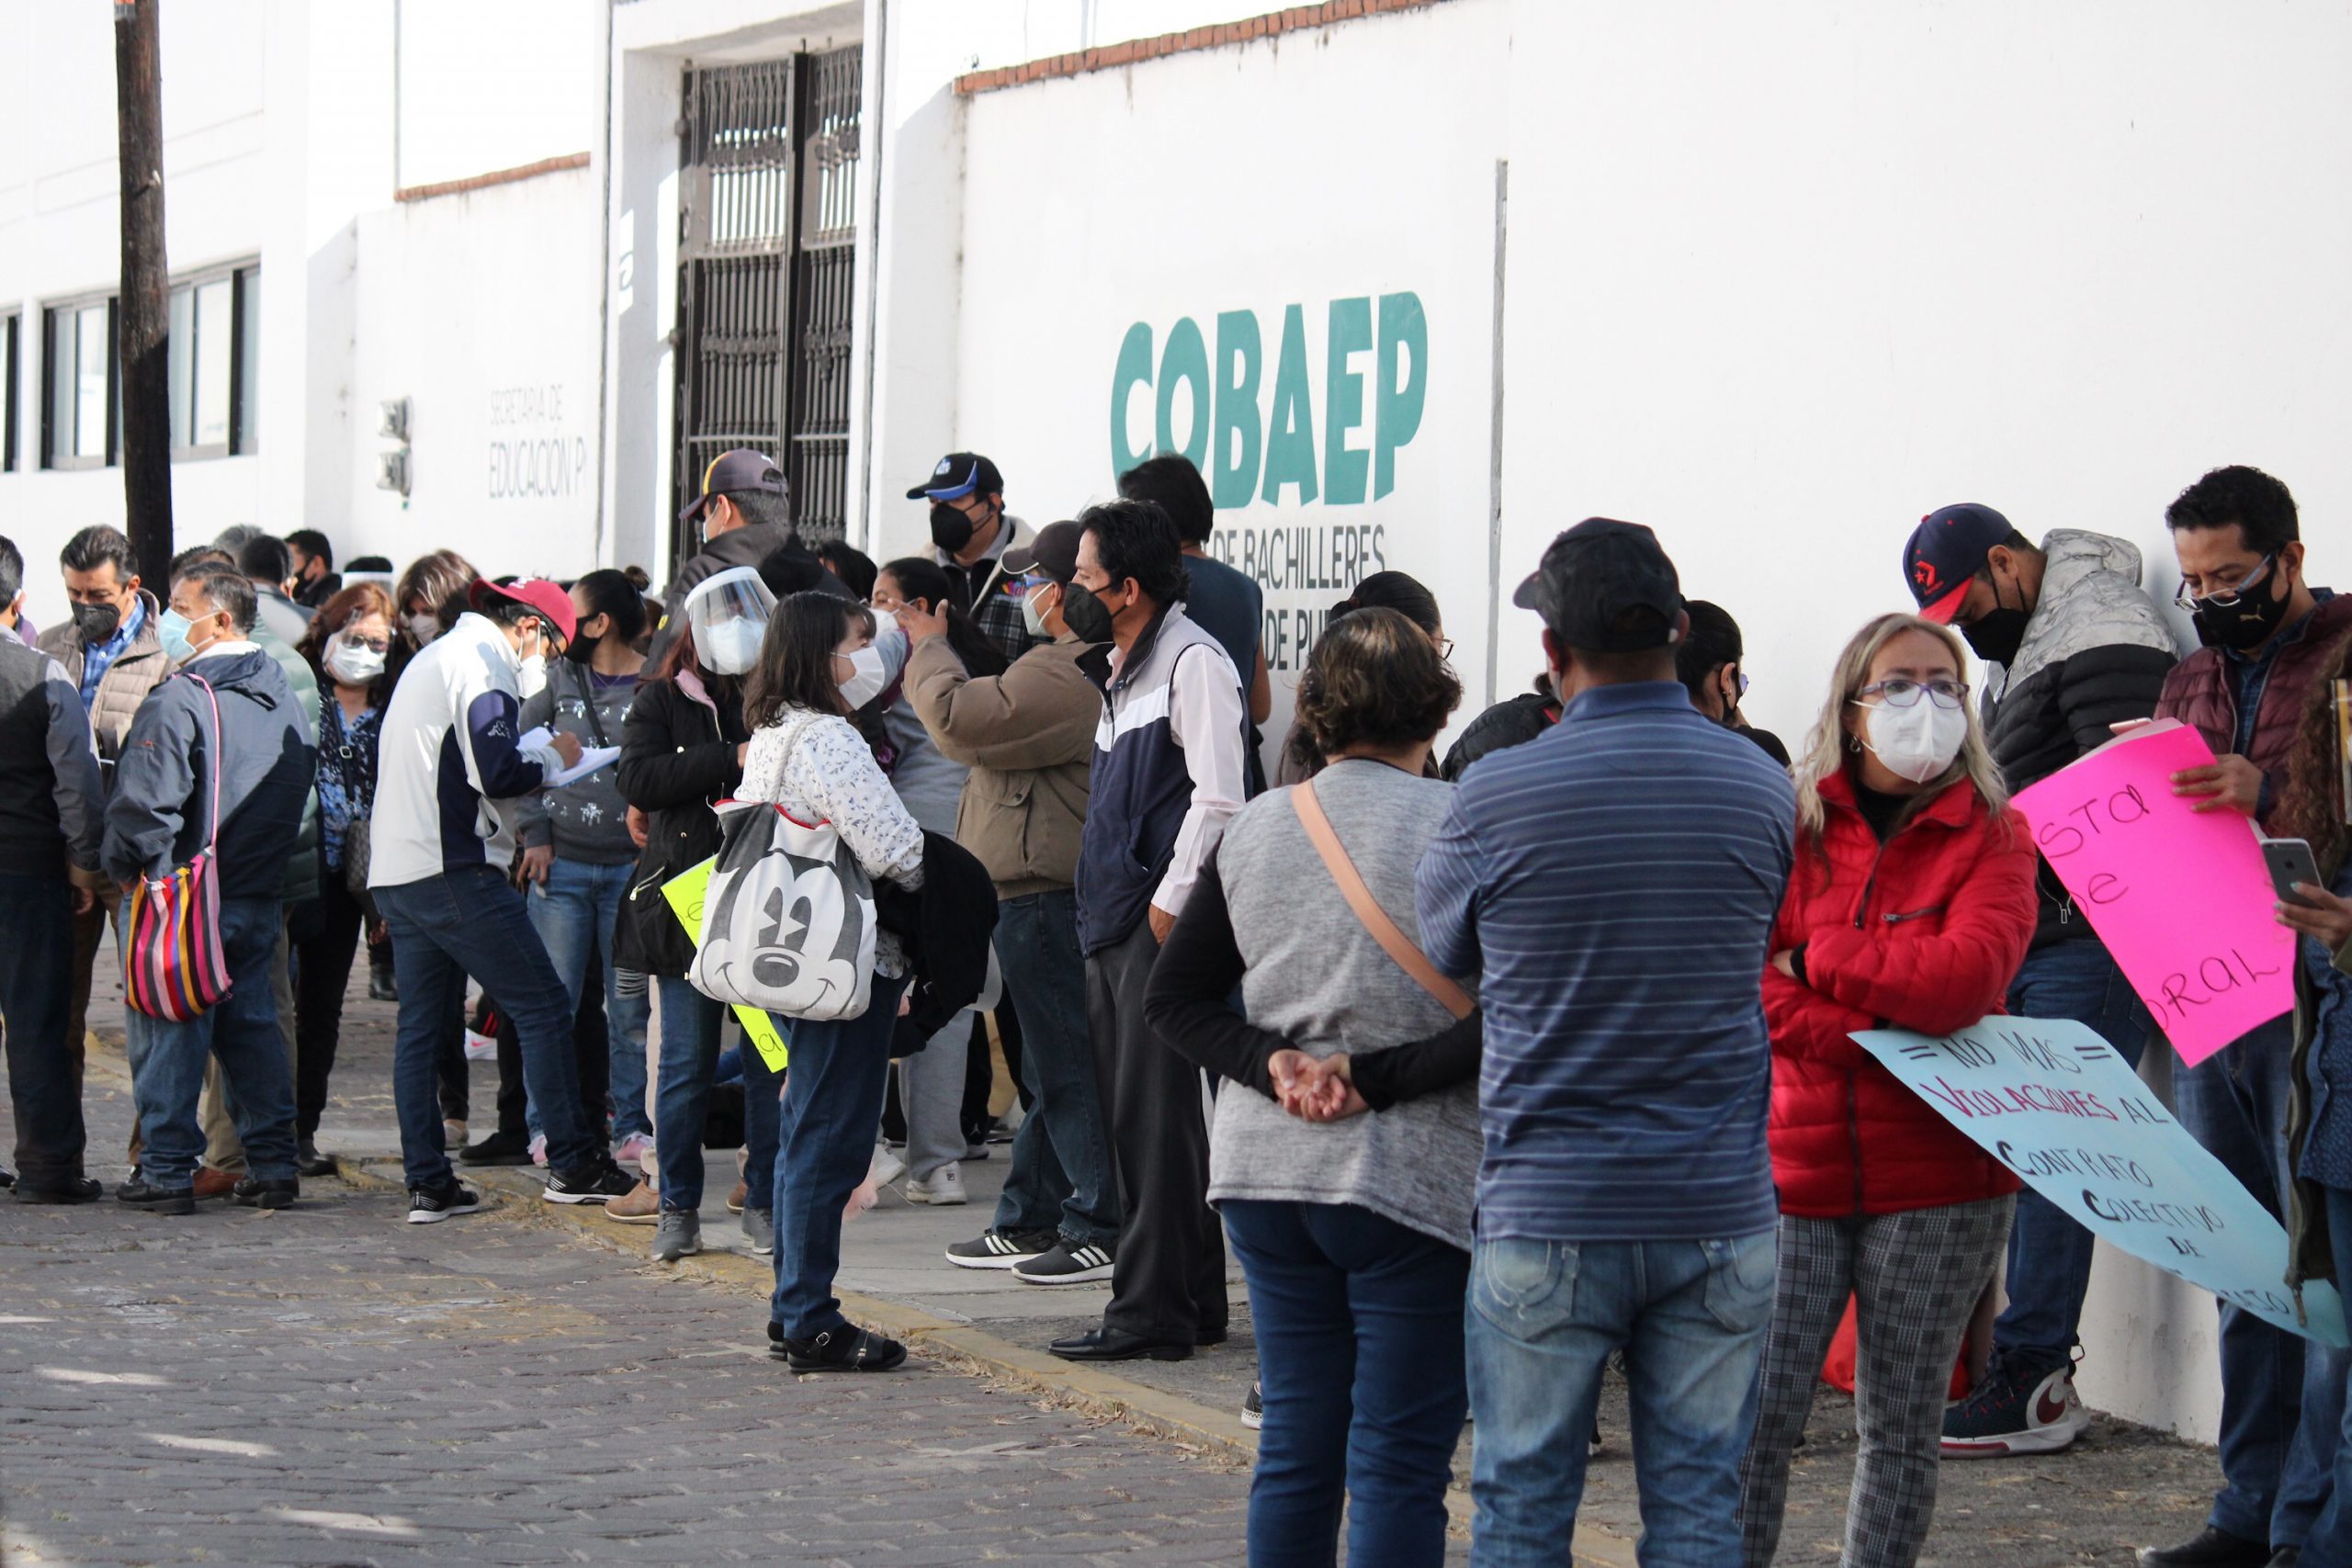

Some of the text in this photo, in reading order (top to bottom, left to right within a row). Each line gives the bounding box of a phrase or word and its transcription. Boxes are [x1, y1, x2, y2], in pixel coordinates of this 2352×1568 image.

[549, 382, 564, 423] DE
[1110, 290, 1429, 510] COBAEP
[1244, 524, 1386, 591] BACHILLERES
[1265, 609, 1288, 671] DE
[1939, 1031, 2082, 1074] NO MAS
[1918, 1075, 2169, 1124] VIOLACIONES AL
[1996, 1139, 2154, 1188] CONTRATO
[2081, 1188, 2225, 1234] COLECTIVO
[2165, 1235, 2206, 1258] DE
